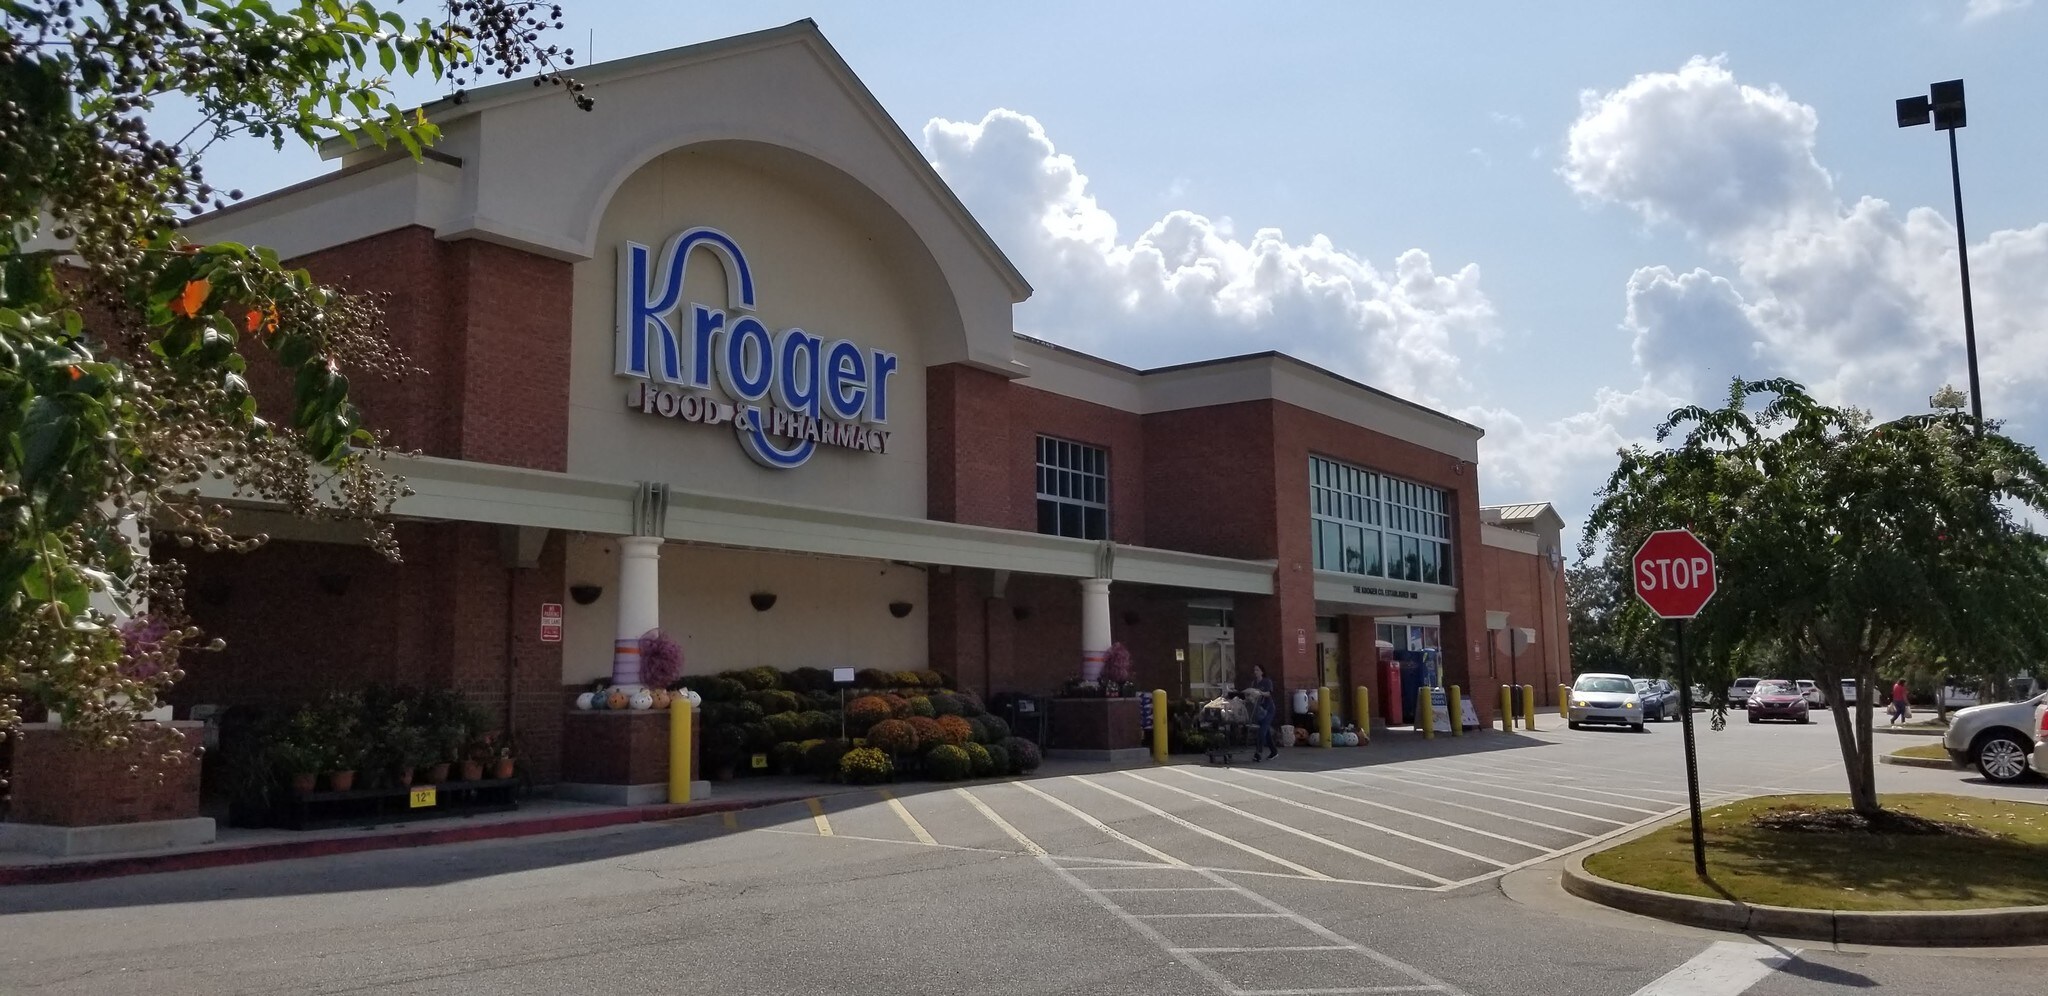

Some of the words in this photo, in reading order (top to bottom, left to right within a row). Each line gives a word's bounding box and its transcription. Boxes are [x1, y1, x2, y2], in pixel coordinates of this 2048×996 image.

[616, 226, 897, 468] Kroger
[639, 383, 720, 425] FOOD
[732, 400, 760, 432] &
[769, 406, 893, 454] PHARMACY
[1361, 587, 1377, 595] KROGER
[1640, 557, 1708, 591] STOP
